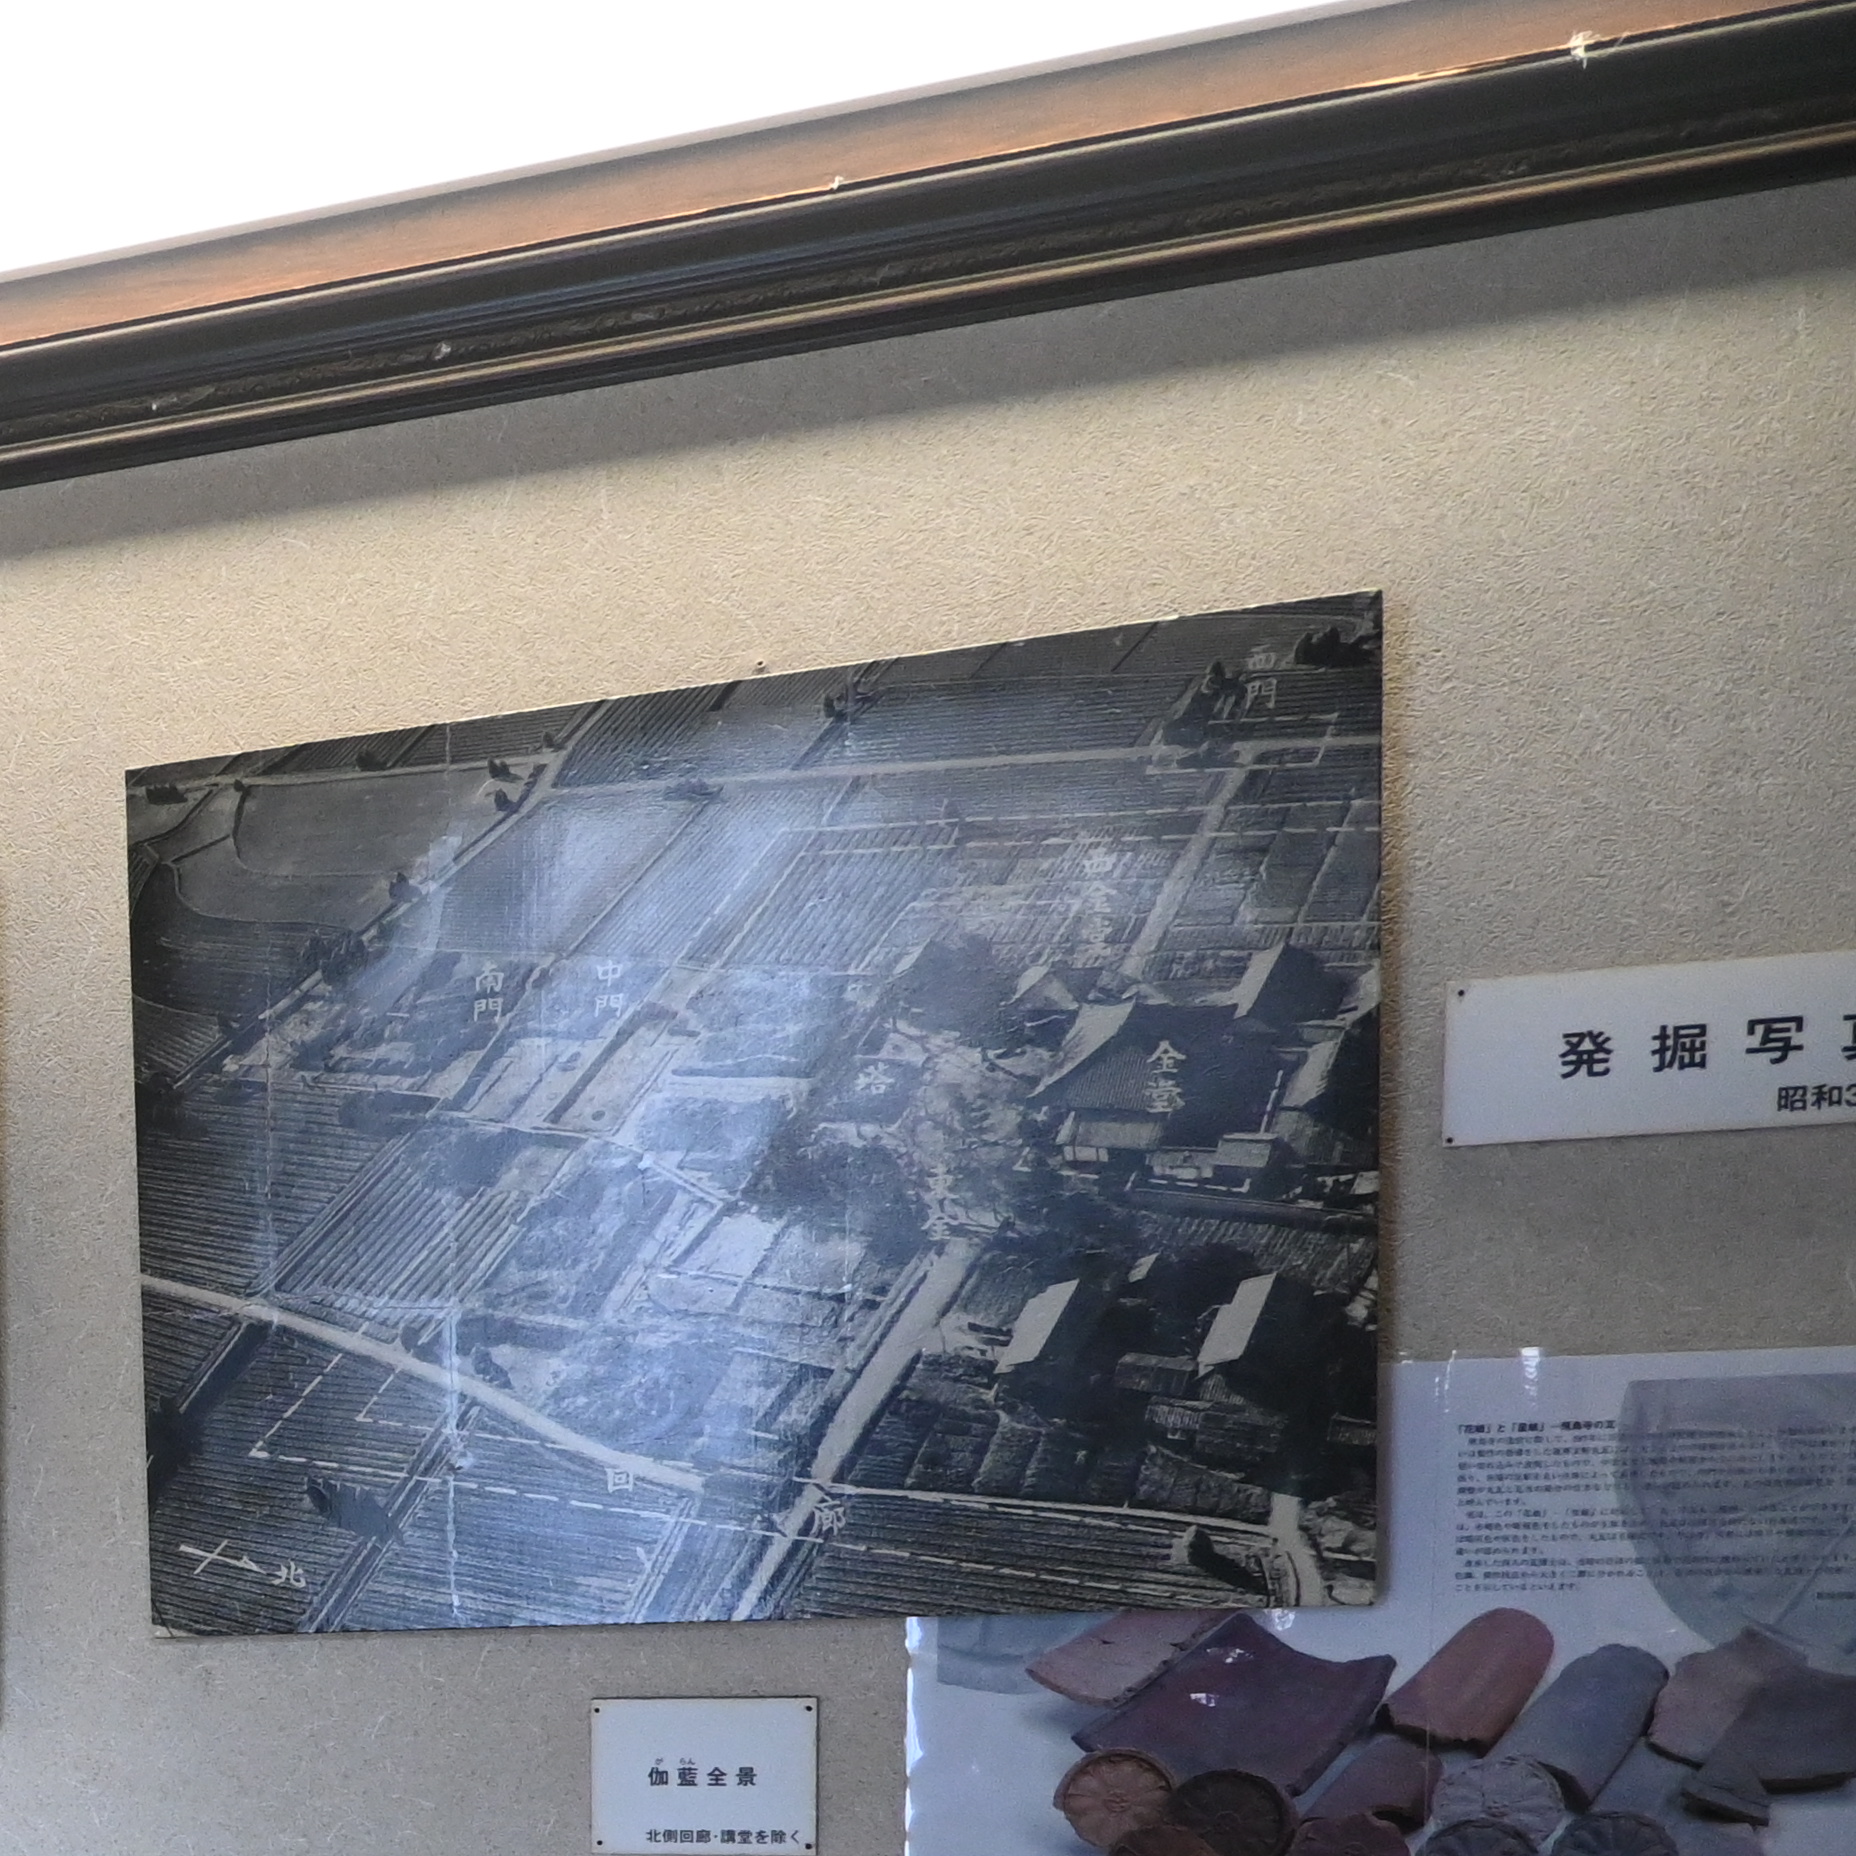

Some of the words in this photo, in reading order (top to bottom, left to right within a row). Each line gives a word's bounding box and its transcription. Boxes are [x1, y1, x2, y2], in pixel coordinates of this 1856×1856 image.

[1559, 1015, 1856, 1080] 発掘写
[648, 1767, 757, 1788] 伽藍全景
[646, 1829, 800, 1845] 北側回廊・講堂を除く
